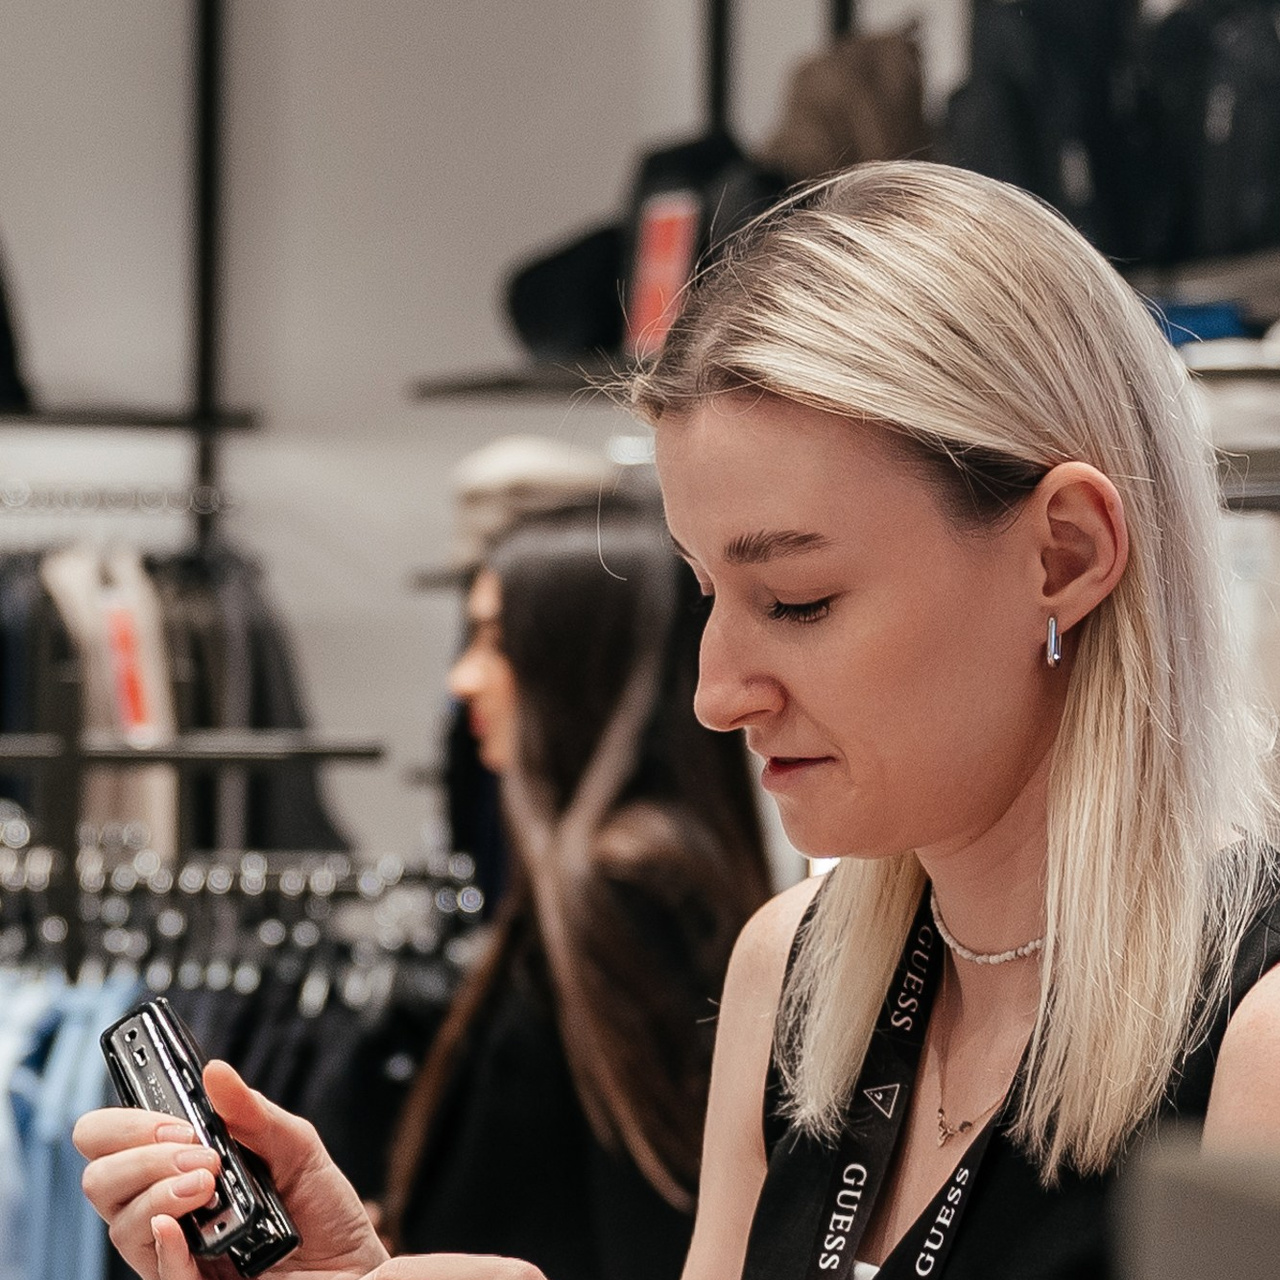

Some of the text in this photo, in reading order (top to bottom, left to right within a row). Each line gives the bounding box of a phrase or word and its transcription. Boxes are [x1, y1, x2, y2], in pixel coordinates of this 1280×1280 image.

[890, 925, 933, 1031] GUESS
[818, 1163, 868, 1270] GUESS
[915, 1167, 970, 1277] GUESS
